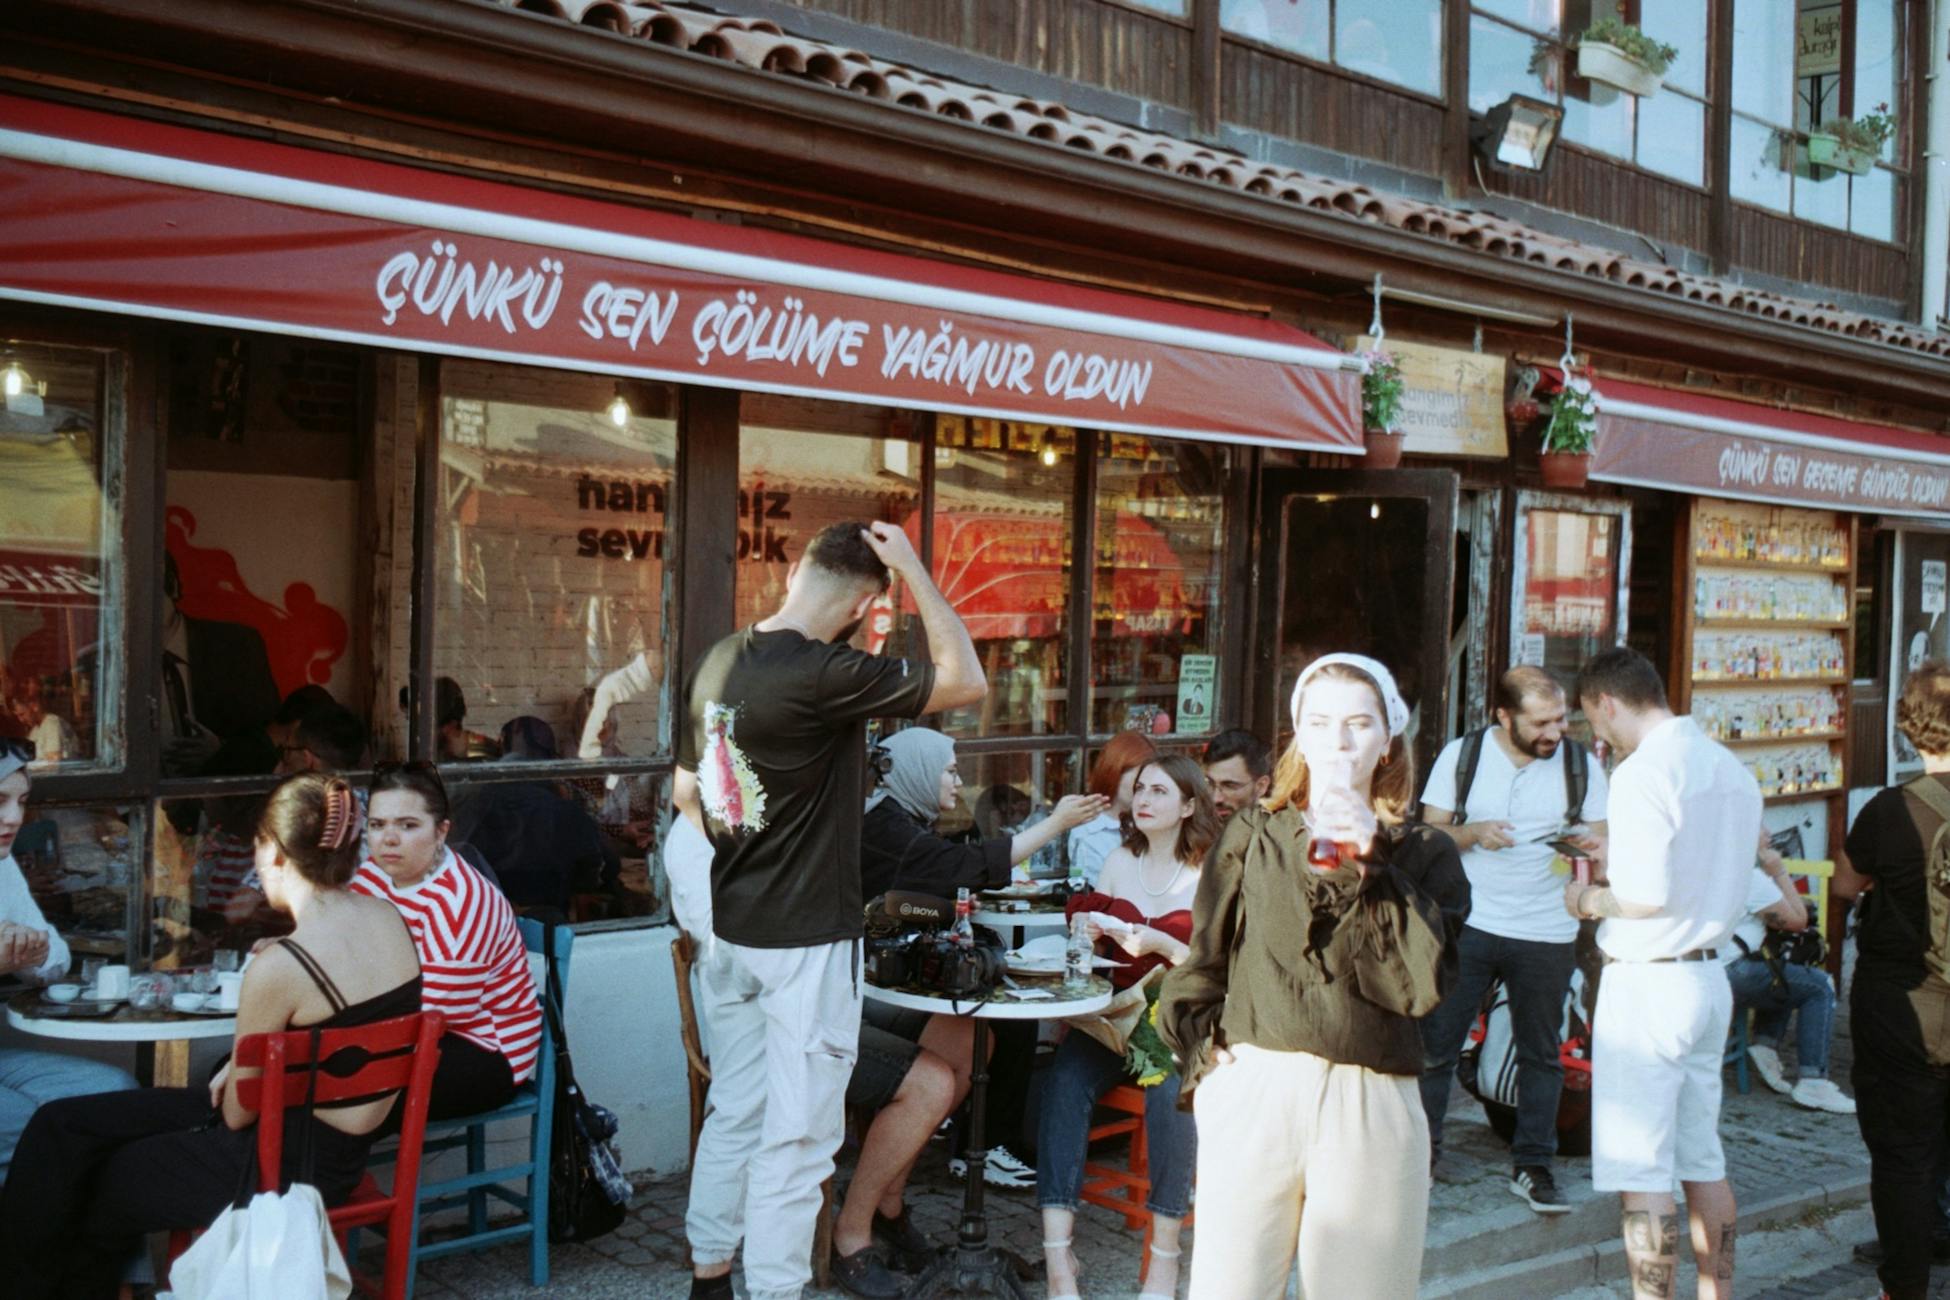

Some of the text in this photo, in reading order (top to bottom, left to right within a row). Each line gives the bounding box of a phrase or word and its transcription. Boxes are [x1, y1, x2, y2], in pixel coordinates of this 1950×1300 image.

[377, 239, 1153, 411] ÇÜNKÜ SEN ÇÖLÜME YAĞMUR OLDUN
[1719, 440, 1771, 488] ÇÜNKÜ
[1773, 452, 1800, 488] SEN
[912, 905, 940, 918] BOYA
